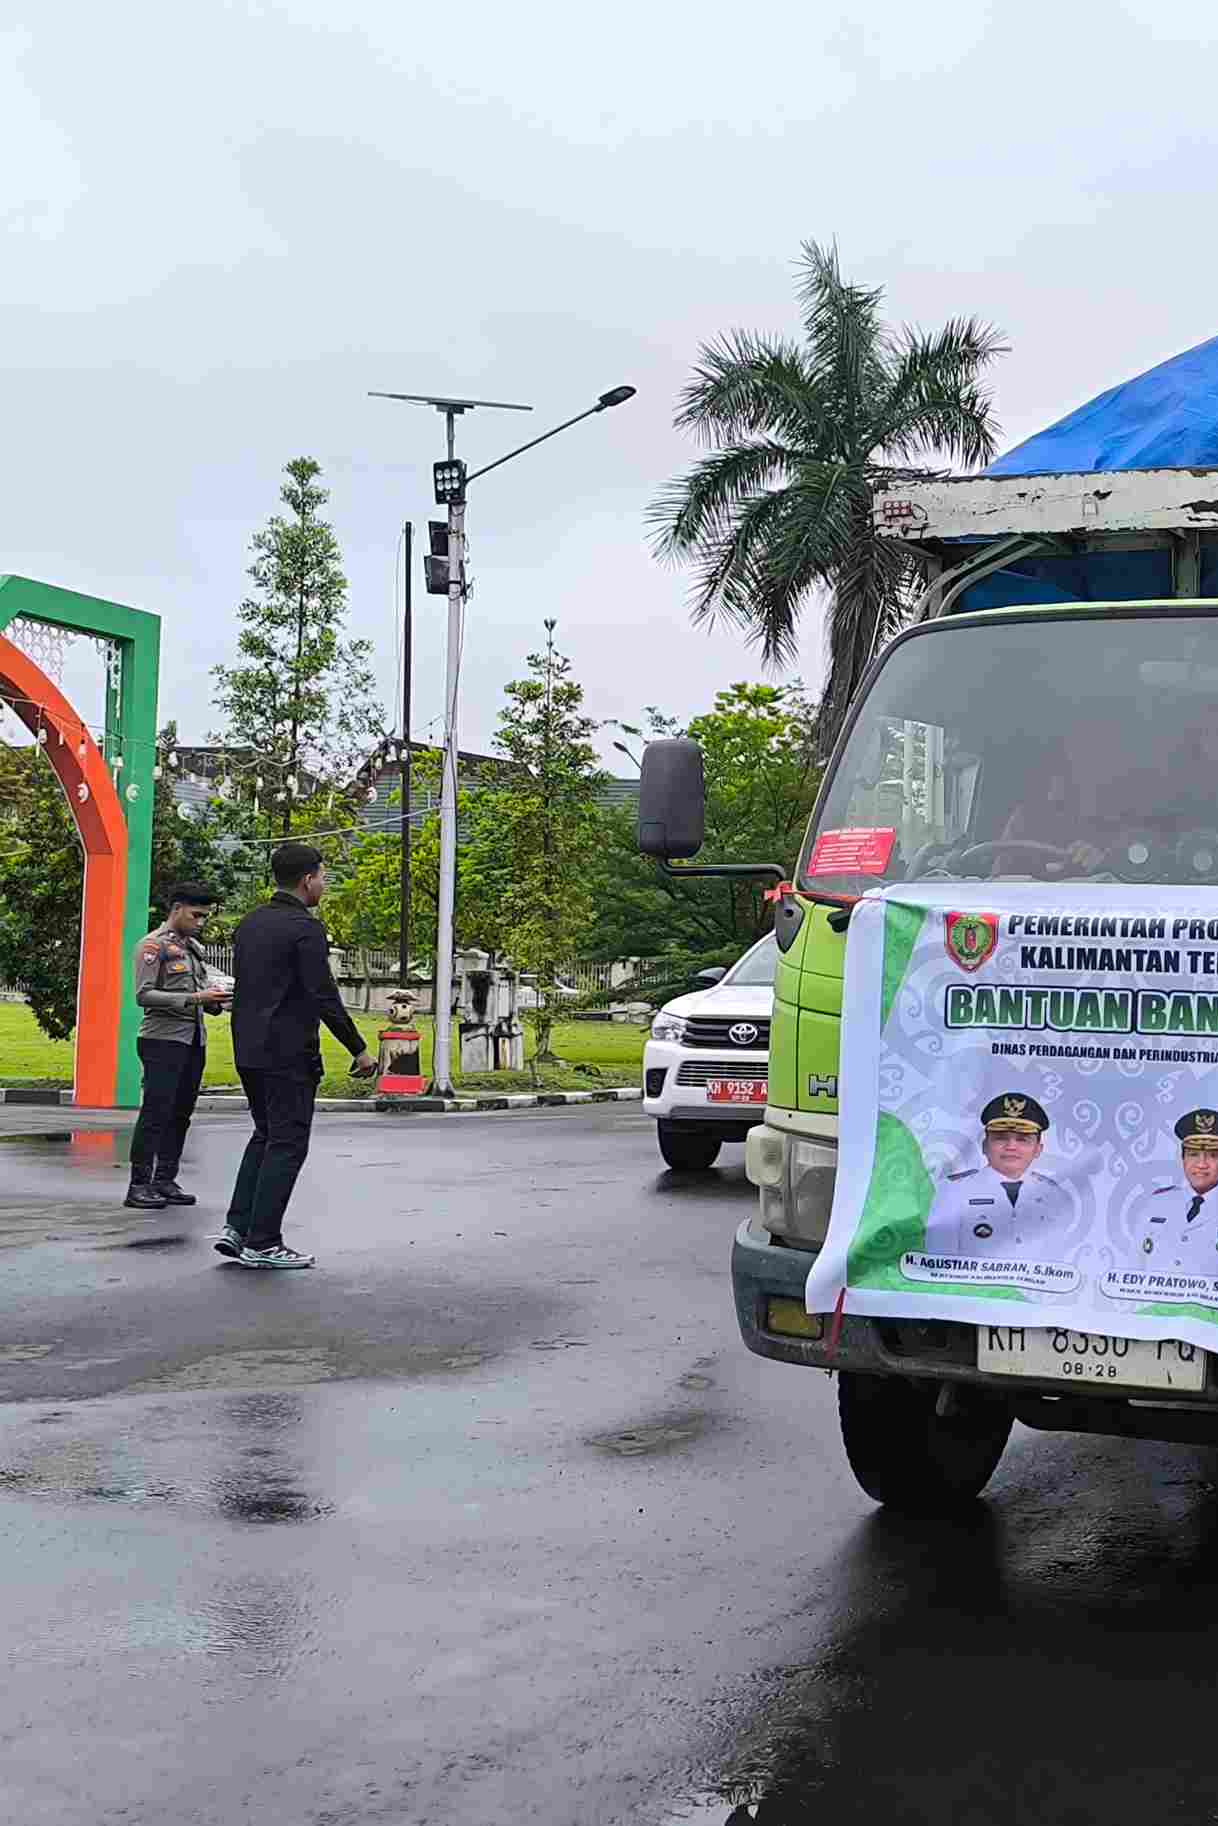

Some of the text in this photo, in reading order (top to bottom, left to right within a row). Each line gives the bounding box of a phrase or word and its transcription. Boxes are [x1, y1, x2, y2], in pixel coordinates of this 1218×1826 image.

[1008, 914, 1165, 939] PEMERINTAH
[1020, 945, 1180, 973] KALIMANTAN
[947, 985, 1133, 1032] BANTUAN
[992, 1043, 1026, 1055] DINAS
[1029, 1045, 1110, 1060] PERDAGANGAN
[1113, 1048, 1136, 1060] DAN
[905, 1254, 917, 1266] H.
[919, 1257, 978, 1271] AGUSTIAR
[1107, 1272, 1119, 1284] H.
[1122, 1273, 1146, 1285] EDY
[1148, 1275, 1210, 1291] PRATOWO,
